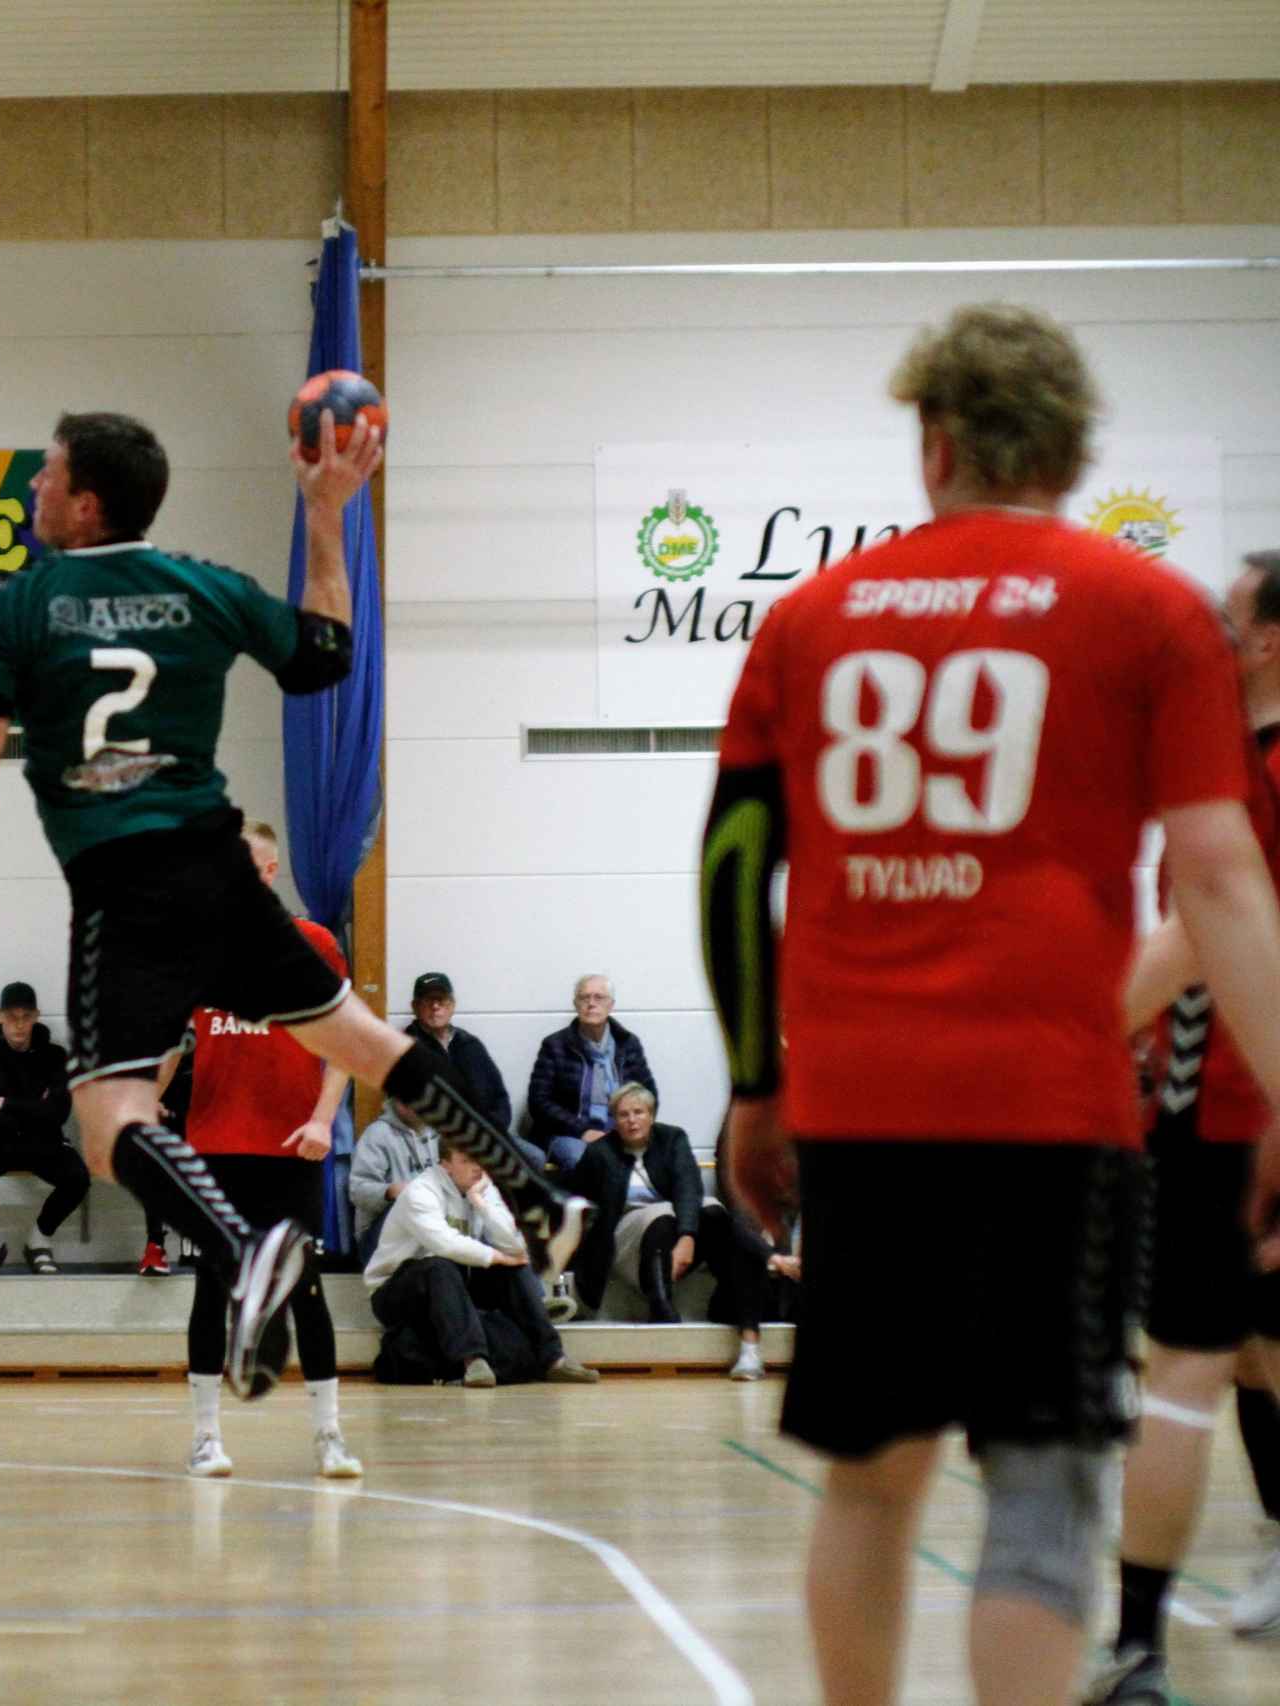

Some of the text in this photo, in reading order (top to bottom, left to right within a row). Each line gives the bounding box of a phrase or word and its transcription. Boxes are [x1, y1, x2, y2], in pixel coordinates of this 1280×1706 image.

[844, 575, 1060, 617] SPORT 24
[83, 648, 158, 761] 2
[818, 648, 1050, 835] 89
[844, 853, 984, 901] TYLVAD
